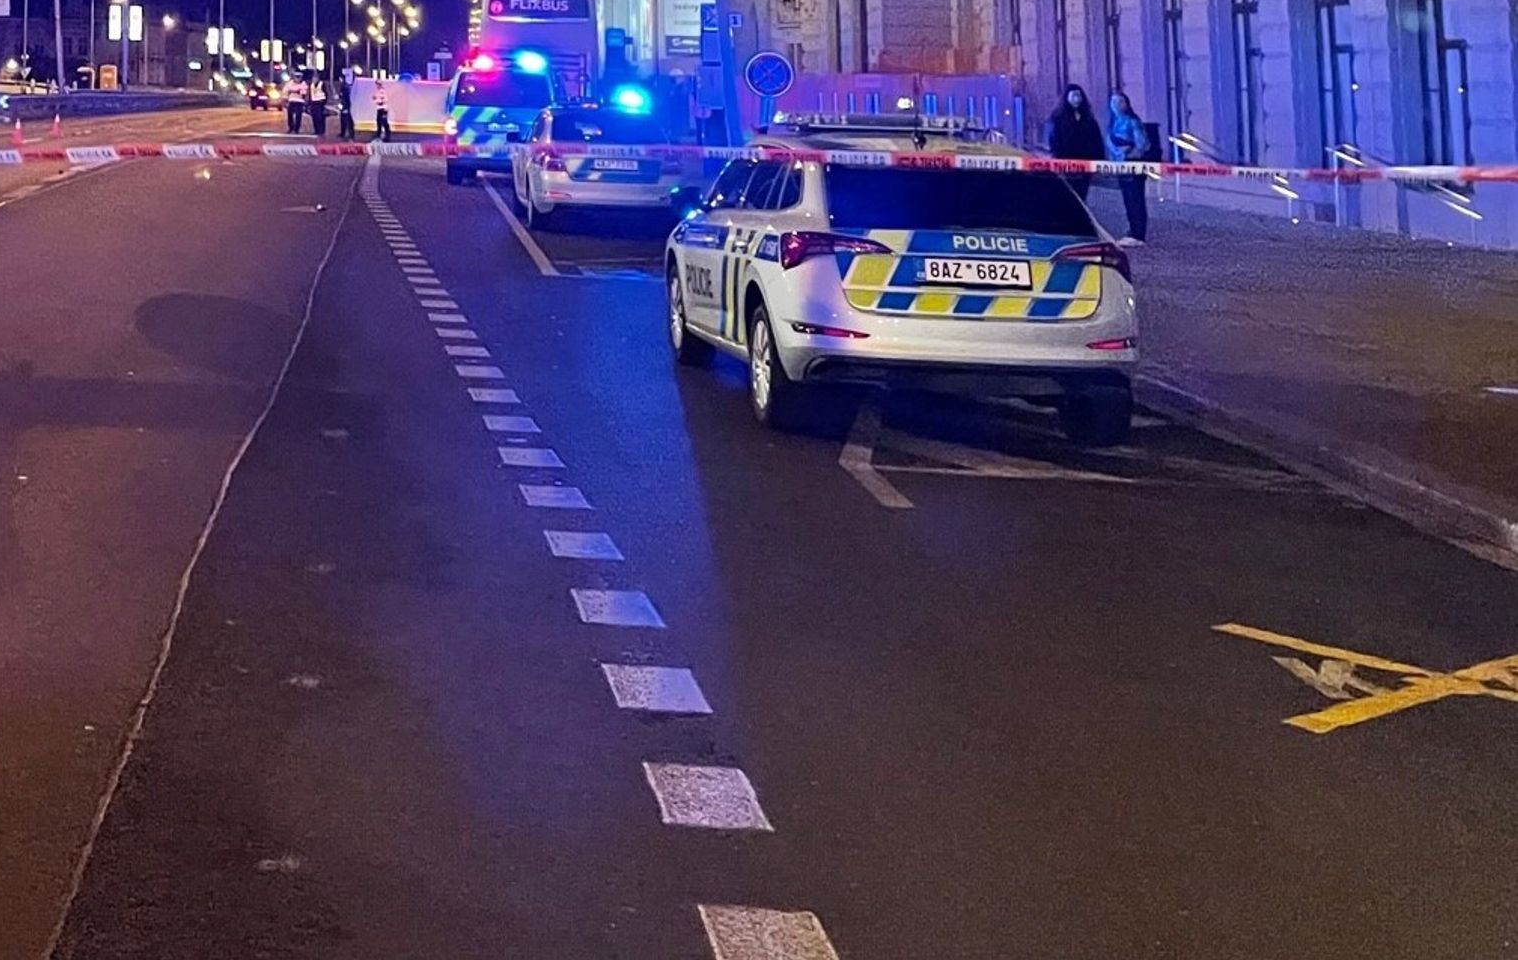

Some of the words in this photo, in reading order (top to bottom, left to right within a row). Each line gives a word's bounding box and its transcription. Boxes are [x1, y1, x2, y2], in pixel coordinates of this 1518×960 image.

[953, 235, 1029, 253] POLICIE
[930, 261, 963, 279] 8AZ
[976, 263, 1020, 281] 6824
